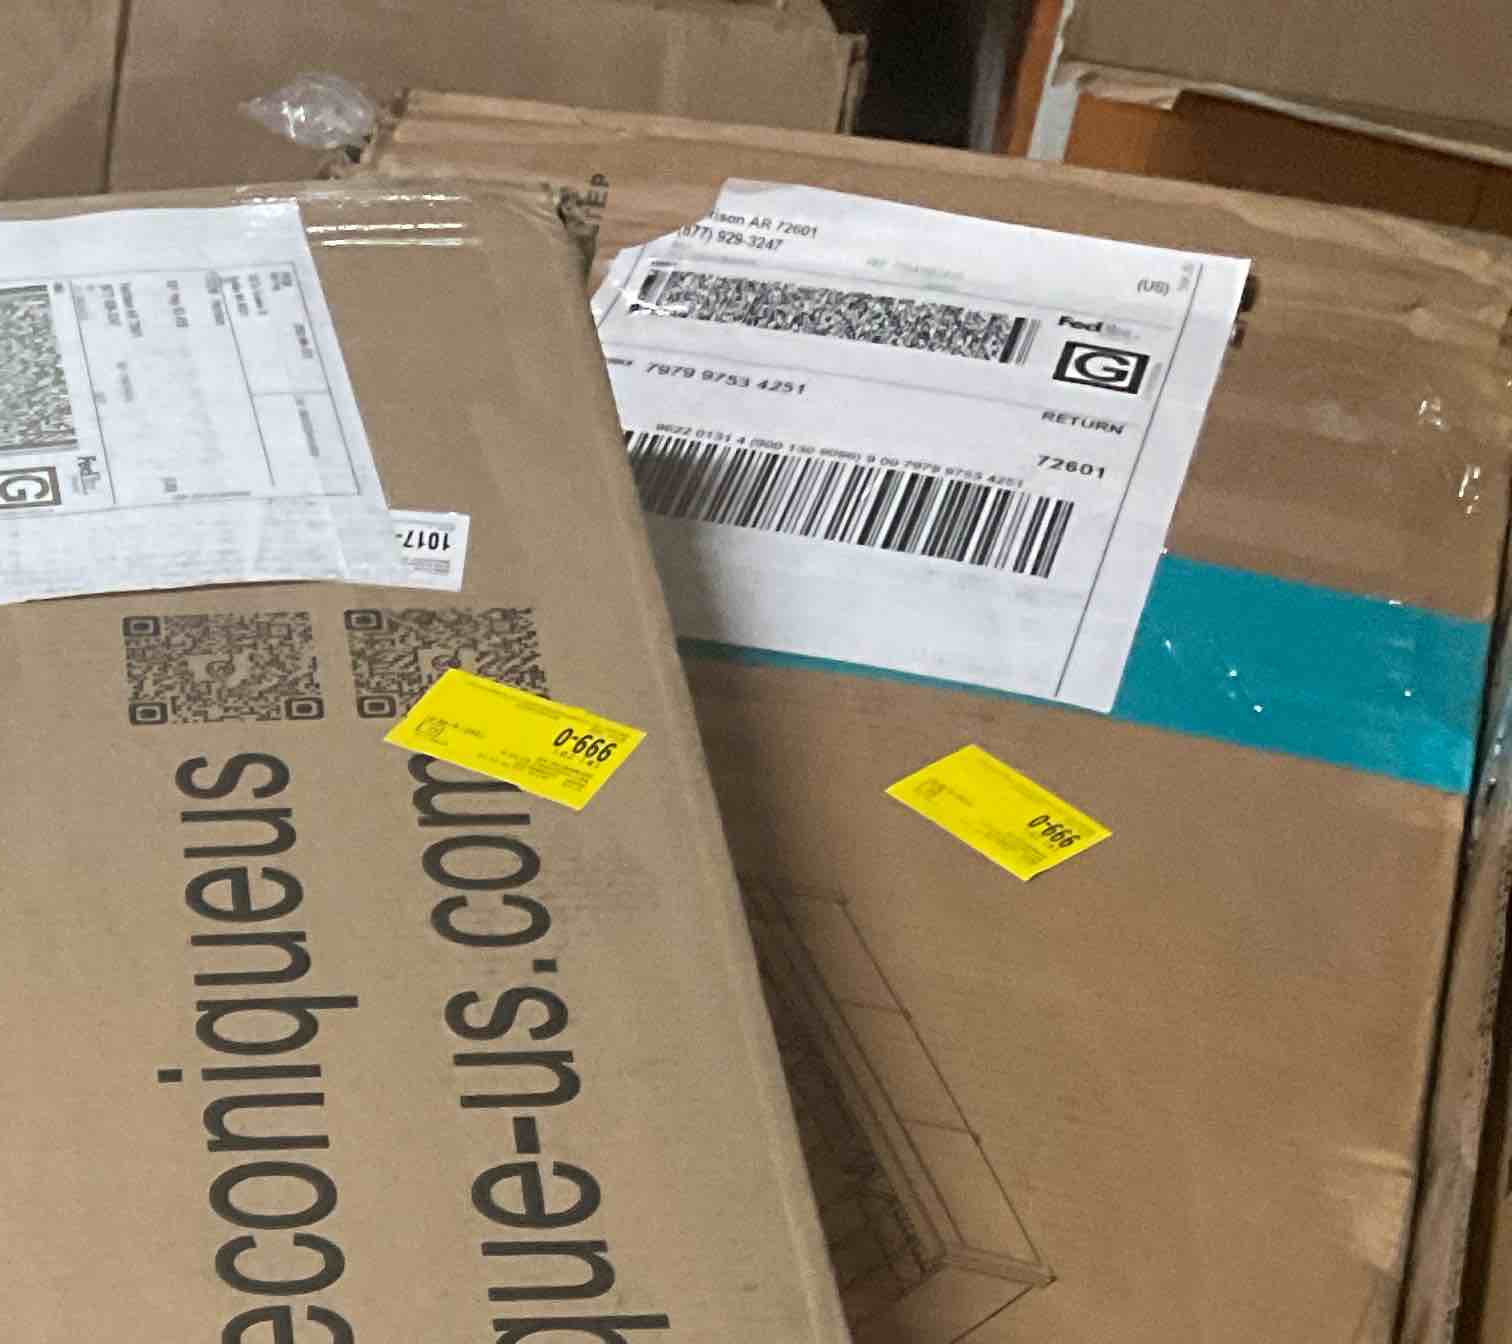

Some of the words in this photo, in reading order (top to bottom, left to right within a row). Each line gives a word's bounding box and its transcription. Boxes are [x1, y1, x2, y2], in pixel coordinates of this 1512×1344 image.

[716, 230, 784, 252] 929-3247
[749, 216, 772, 231] AR
[775, 221, 819, 240] 72601
[1074, 352, 1130, 384] G
[1040, 409, 1126, 436] RETURN
[1036, 454, 1107, 480] 72601
